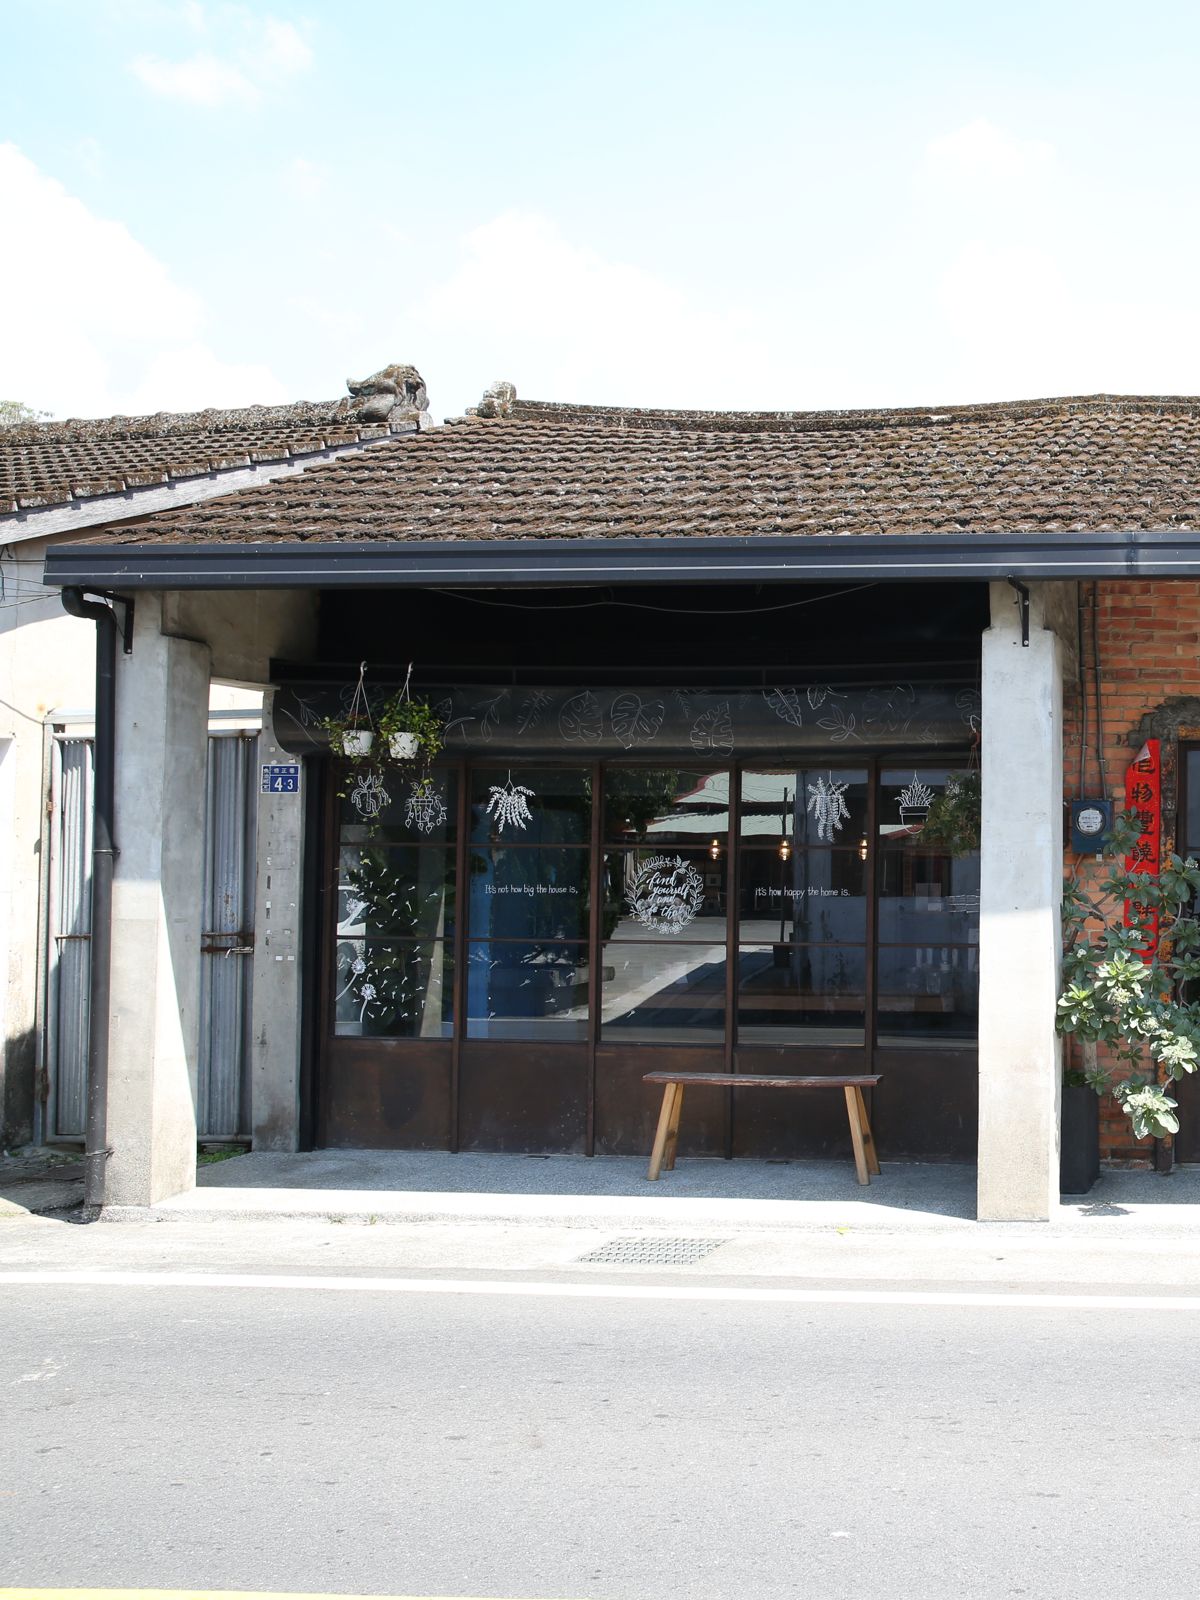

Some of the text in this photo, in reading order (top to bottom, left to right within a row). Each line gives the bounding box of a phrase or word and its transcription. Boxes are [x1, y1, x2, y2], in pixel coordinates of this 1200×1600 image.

[498, 884, 509, 894] not
[510, 884, 523, 894] how
[523, 884, 535, 896] big
[536, 884, 547, 893] the
[548, 884, 567, 894] house
[647, 883, 690, 900] yourself
[768, 886, 782, 896] how
[783, 886, 806, 900] happy
[807, 886, 820, 896] the
[820, 886, 839, 896] home
